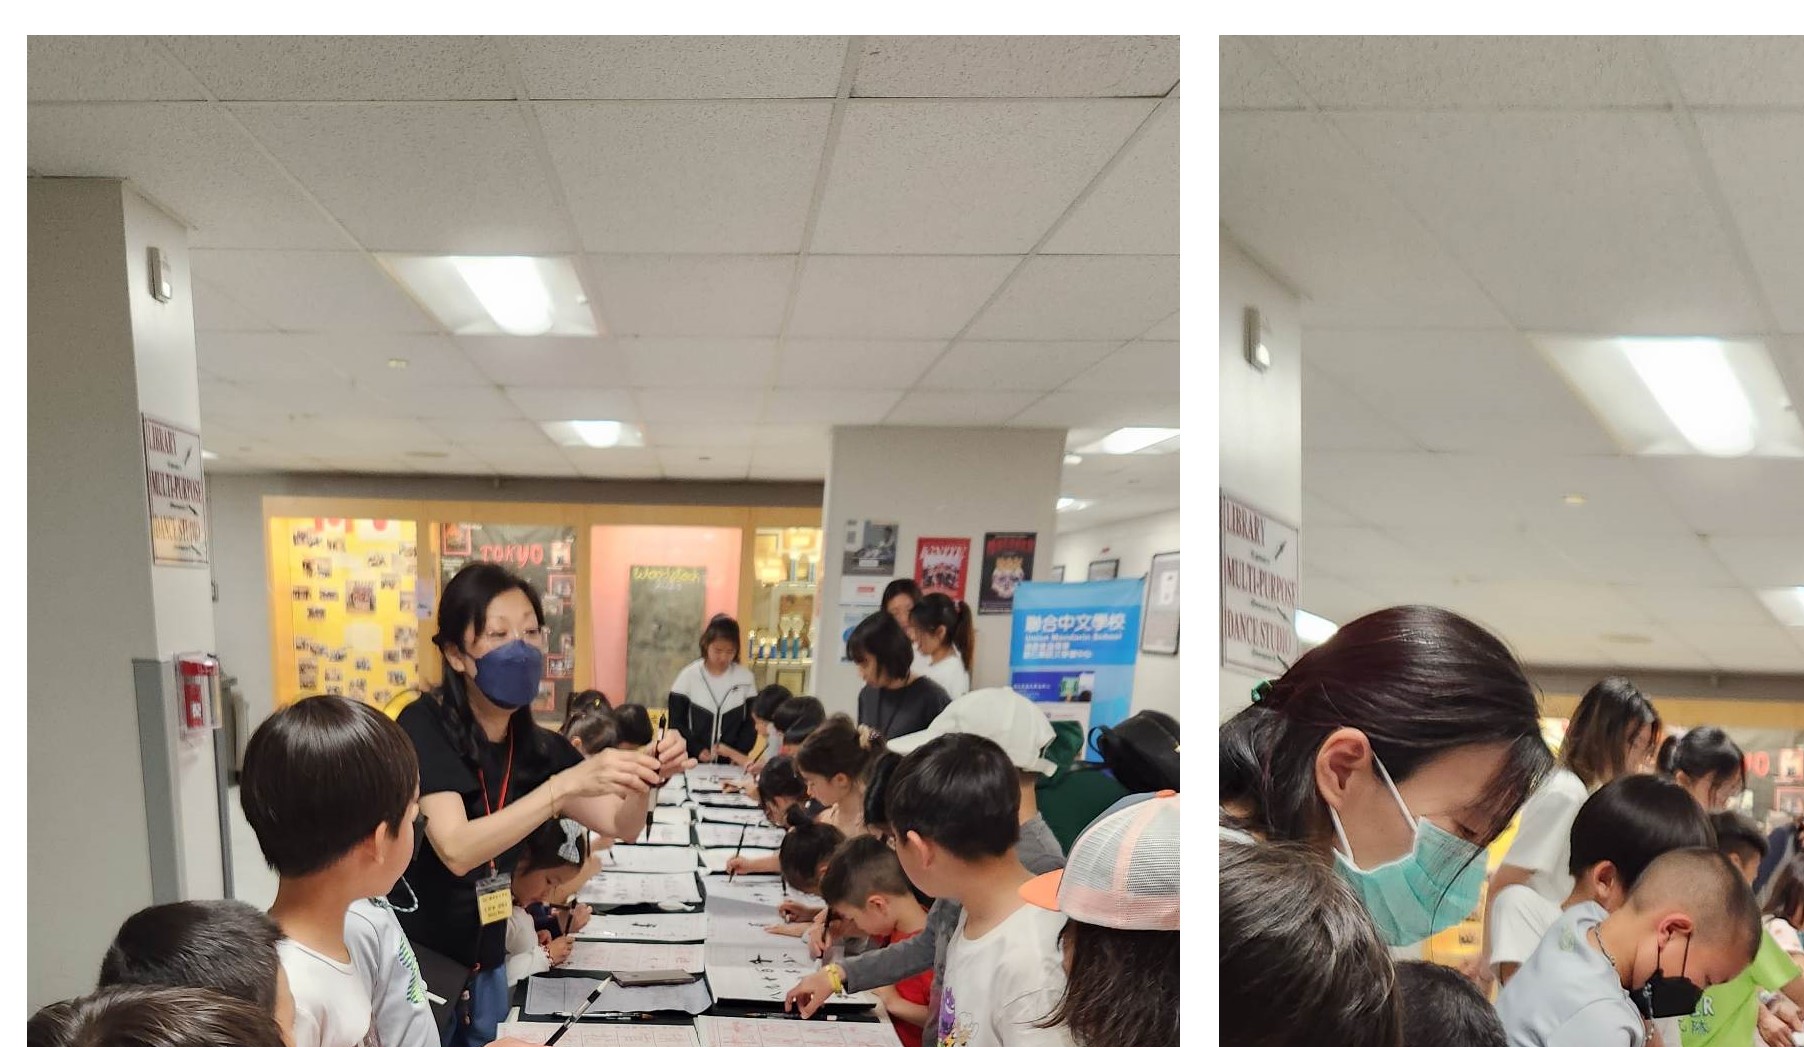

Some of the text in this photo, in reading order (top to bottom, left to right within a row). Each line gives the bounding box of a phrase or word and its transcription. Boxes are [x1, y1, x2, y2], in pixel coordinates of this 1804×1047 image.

[146, 420, 177, 456] LIBRARY
[1226, 500, 1266, 548] LIBRARY
[480, 542, 544, 568] TOKYO
[1227, 556, 1297, 606] MULTI-PURPOSE
[1226, 609, 1292, 655] DANCE STUDIO
